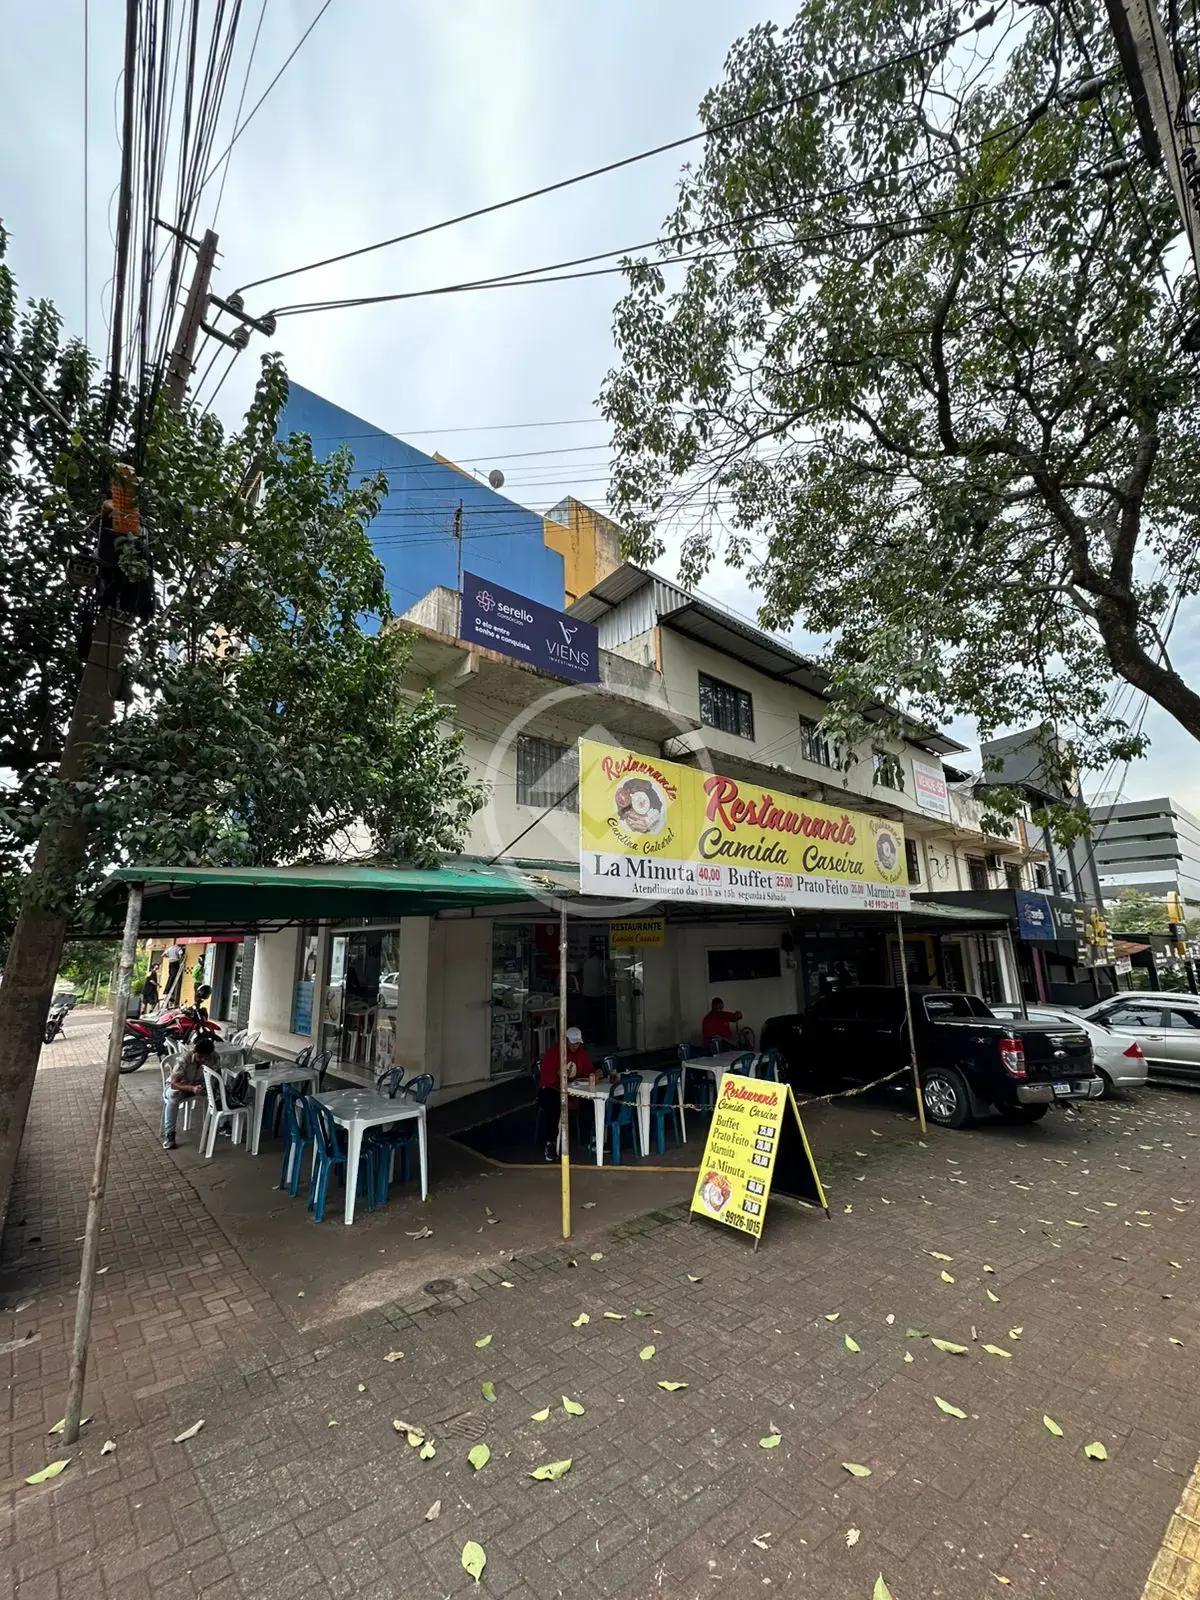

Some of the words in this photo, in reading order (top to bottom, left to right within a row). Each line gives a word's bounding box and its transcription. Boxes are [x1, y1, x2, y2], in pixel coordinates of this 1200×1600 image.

[497, 602, 533, 624] serello
[475, 617, 482, 625] O
[493, 626, 511, 637] entre
[475, 626, 495, 638] sonho
[545, 639, 590, 667] VIENS
[601, 753, 678, 801] Restaurante
[703, 775, 857, 846] Restaurante
[606, 817, 639, 851] Cantina
[802, 845, 865, 875] Caseira
[593, 854, 621, 877] La
[625, 857, 695, 883] Minuta
[698, 867, 721, 884] 40,00
[728, 867, 773, 889] Buffet
[796, 875, 824, 893] Prato
[825, 879, 849, 896] Feito
[866, 883, 895, 899] Marmita
[631, 882, 684, 896] Atendimento
[685, 885, 698, 897] das
[610, 921, 663, 931] RESTAURANTE
[722, 1080, 778, 1107] Restaurante
[715, 1114, 740, 1131] Buffet
[749, 1105, 778, 1121] Caseira
[712, 1127, 731, 1142] Prato
[731, 1131, 750, 1147] Feito
[709, 1141, 736, 1159] Marmita
[705, 1155, 716, 1170] La
[716, 1159, 746, 1179] Minuta
[724, 1210, 761, 1235] 99126-1015
